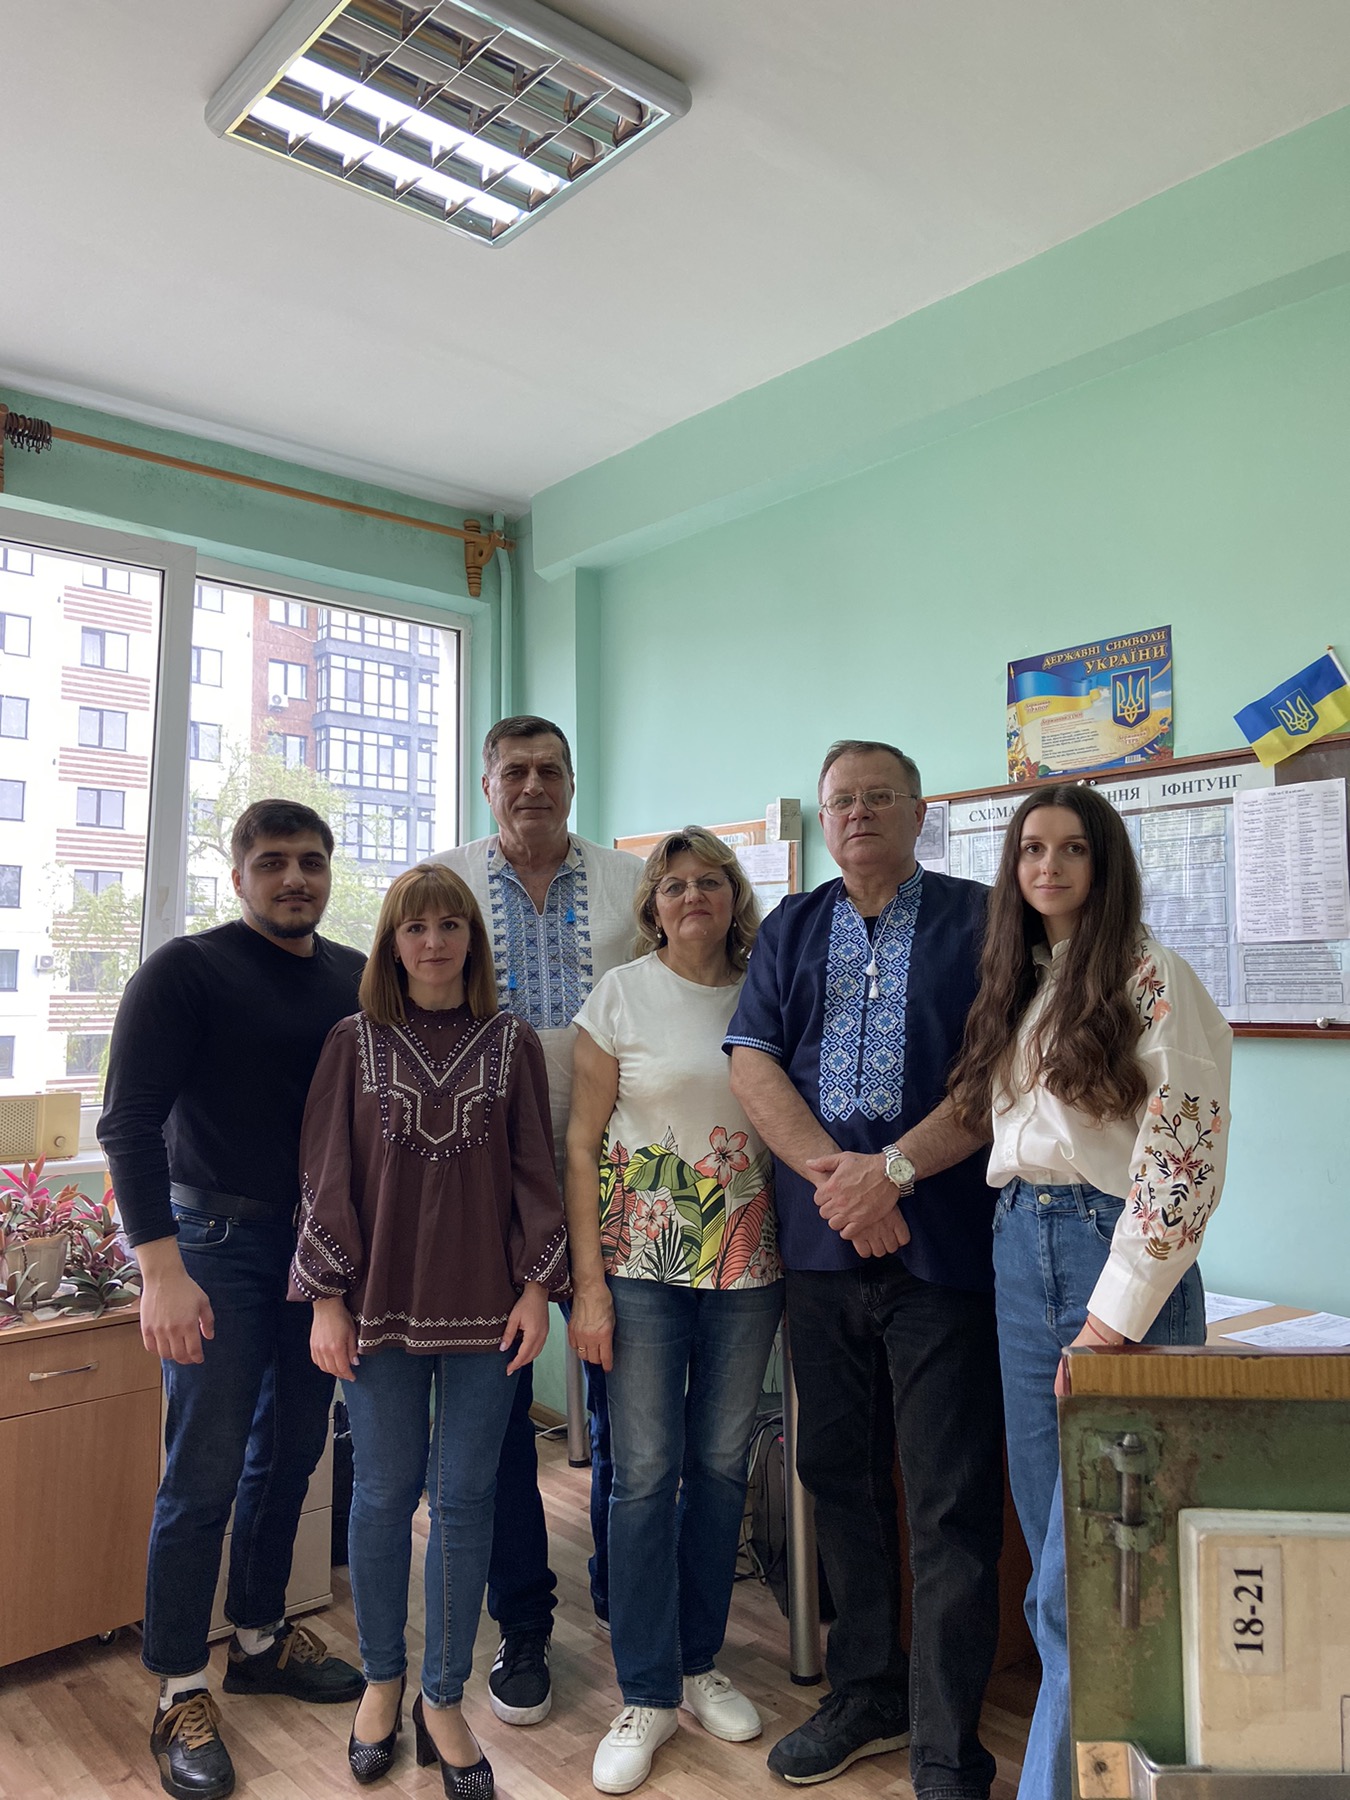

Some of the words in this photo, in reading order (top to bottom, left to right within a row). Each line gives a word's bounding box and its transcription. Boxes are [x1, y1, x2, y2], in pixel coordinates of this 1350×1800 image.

[1043, 646, 1100, 669] ДЕРЖАВНІ
[1106, 631, 1166, 651] СИМВОЛИ
[1085, 645, 1167, 674] УКРАЇНИ
[1161, 774, 1243, 798] ІФНТУНГ
[1233, 1565, 1264, 1655] 18-21
